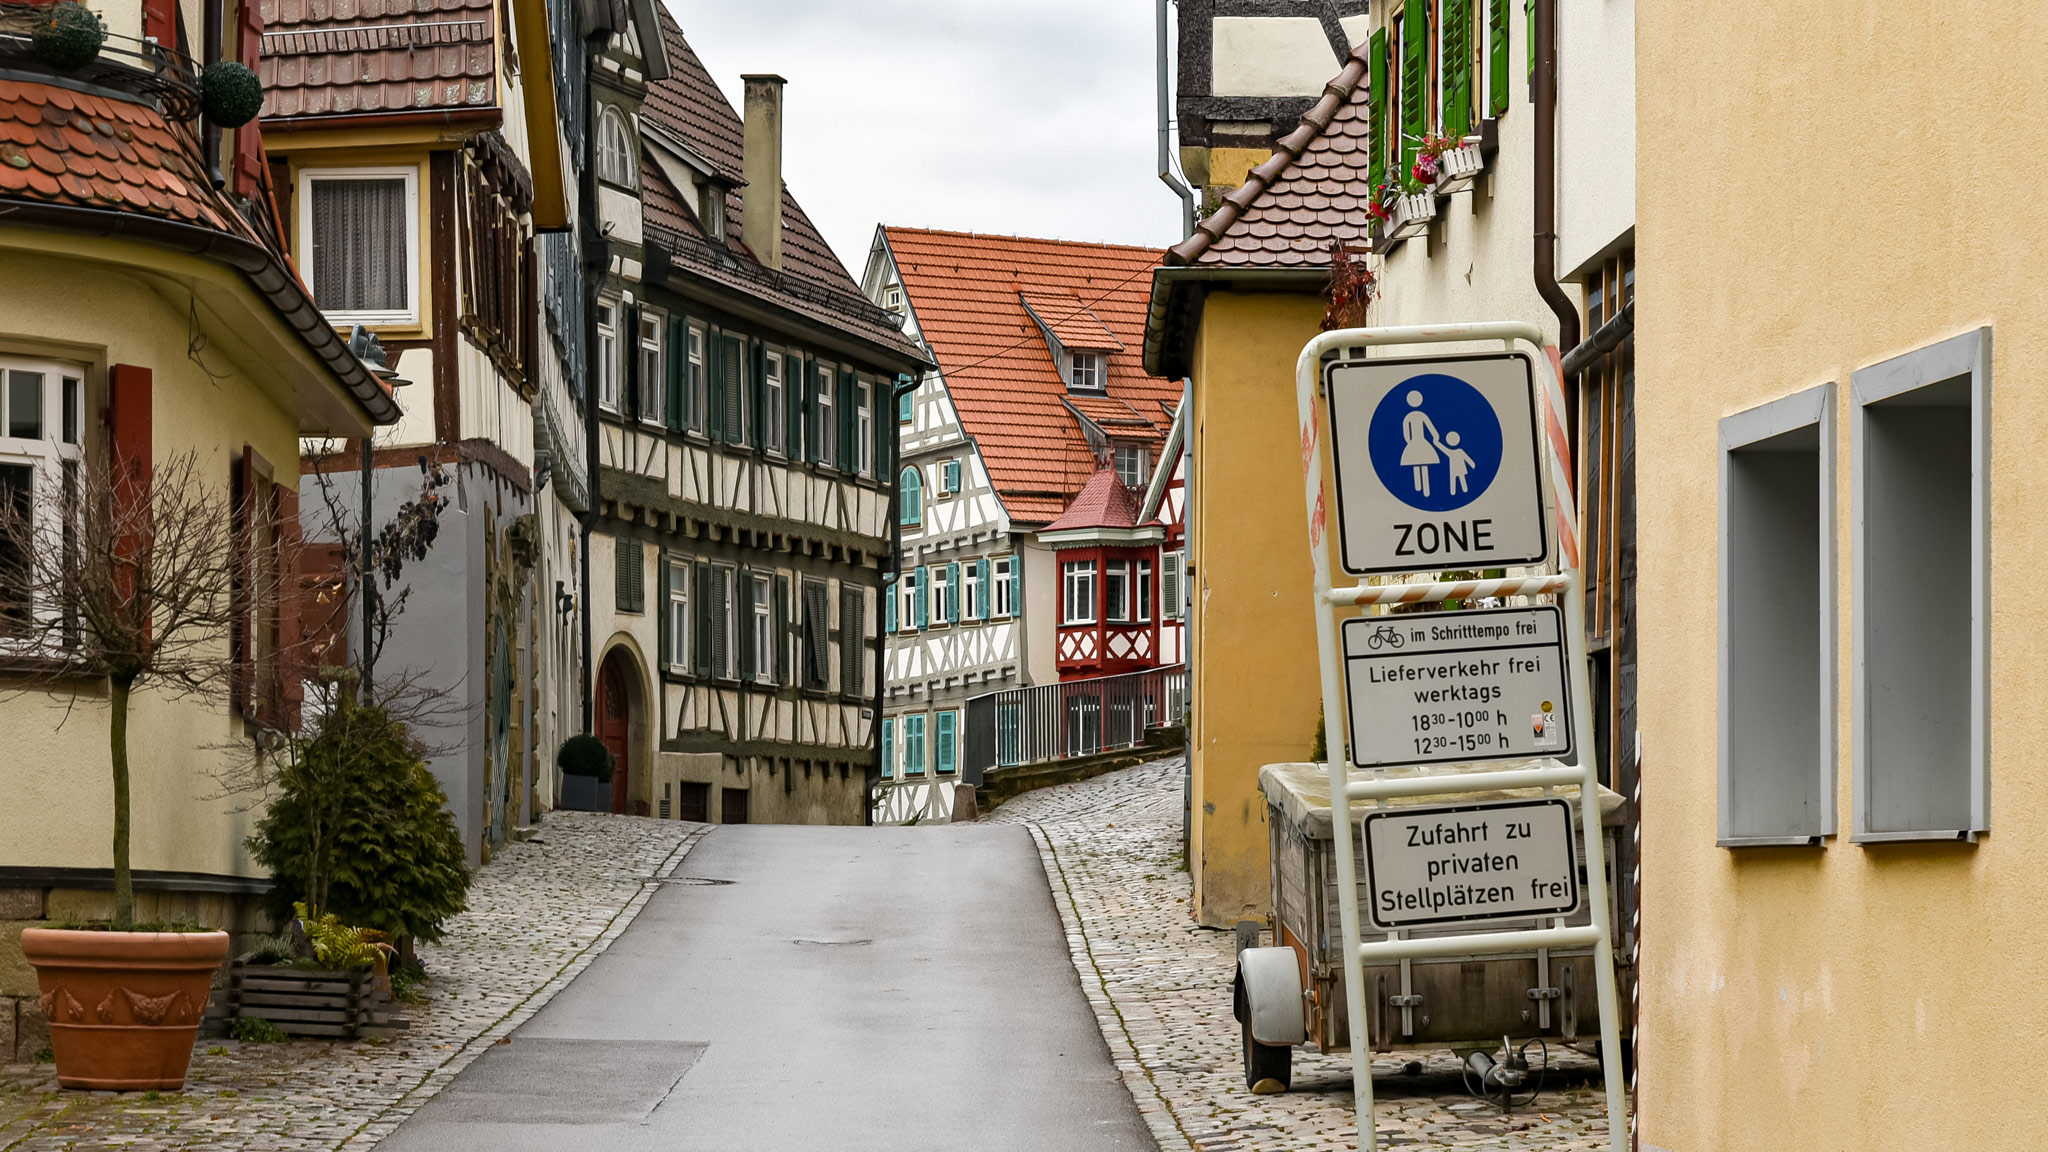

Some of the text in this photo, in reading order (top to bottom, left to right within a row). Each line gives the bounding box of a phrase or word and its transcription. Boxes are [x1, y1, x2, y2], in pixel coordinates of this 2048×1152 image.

[1393, 519, 1495, 556] ZONE
[1410, 620, 1537, 643] im Schritttempo frei
[1369, 656, 1541, 683] Lieferverkehr frei
[1413, 684, 1502, 704] werktags
[1496, 709, 1508, 726] h
[1498, 732, 1510, 749] h
[1406, 821, 1532, 847] Zufahrt zu
[1427, 852, 1519, 882] privaten
[1381, 876, 1569, 913] Stellplätzen frei
